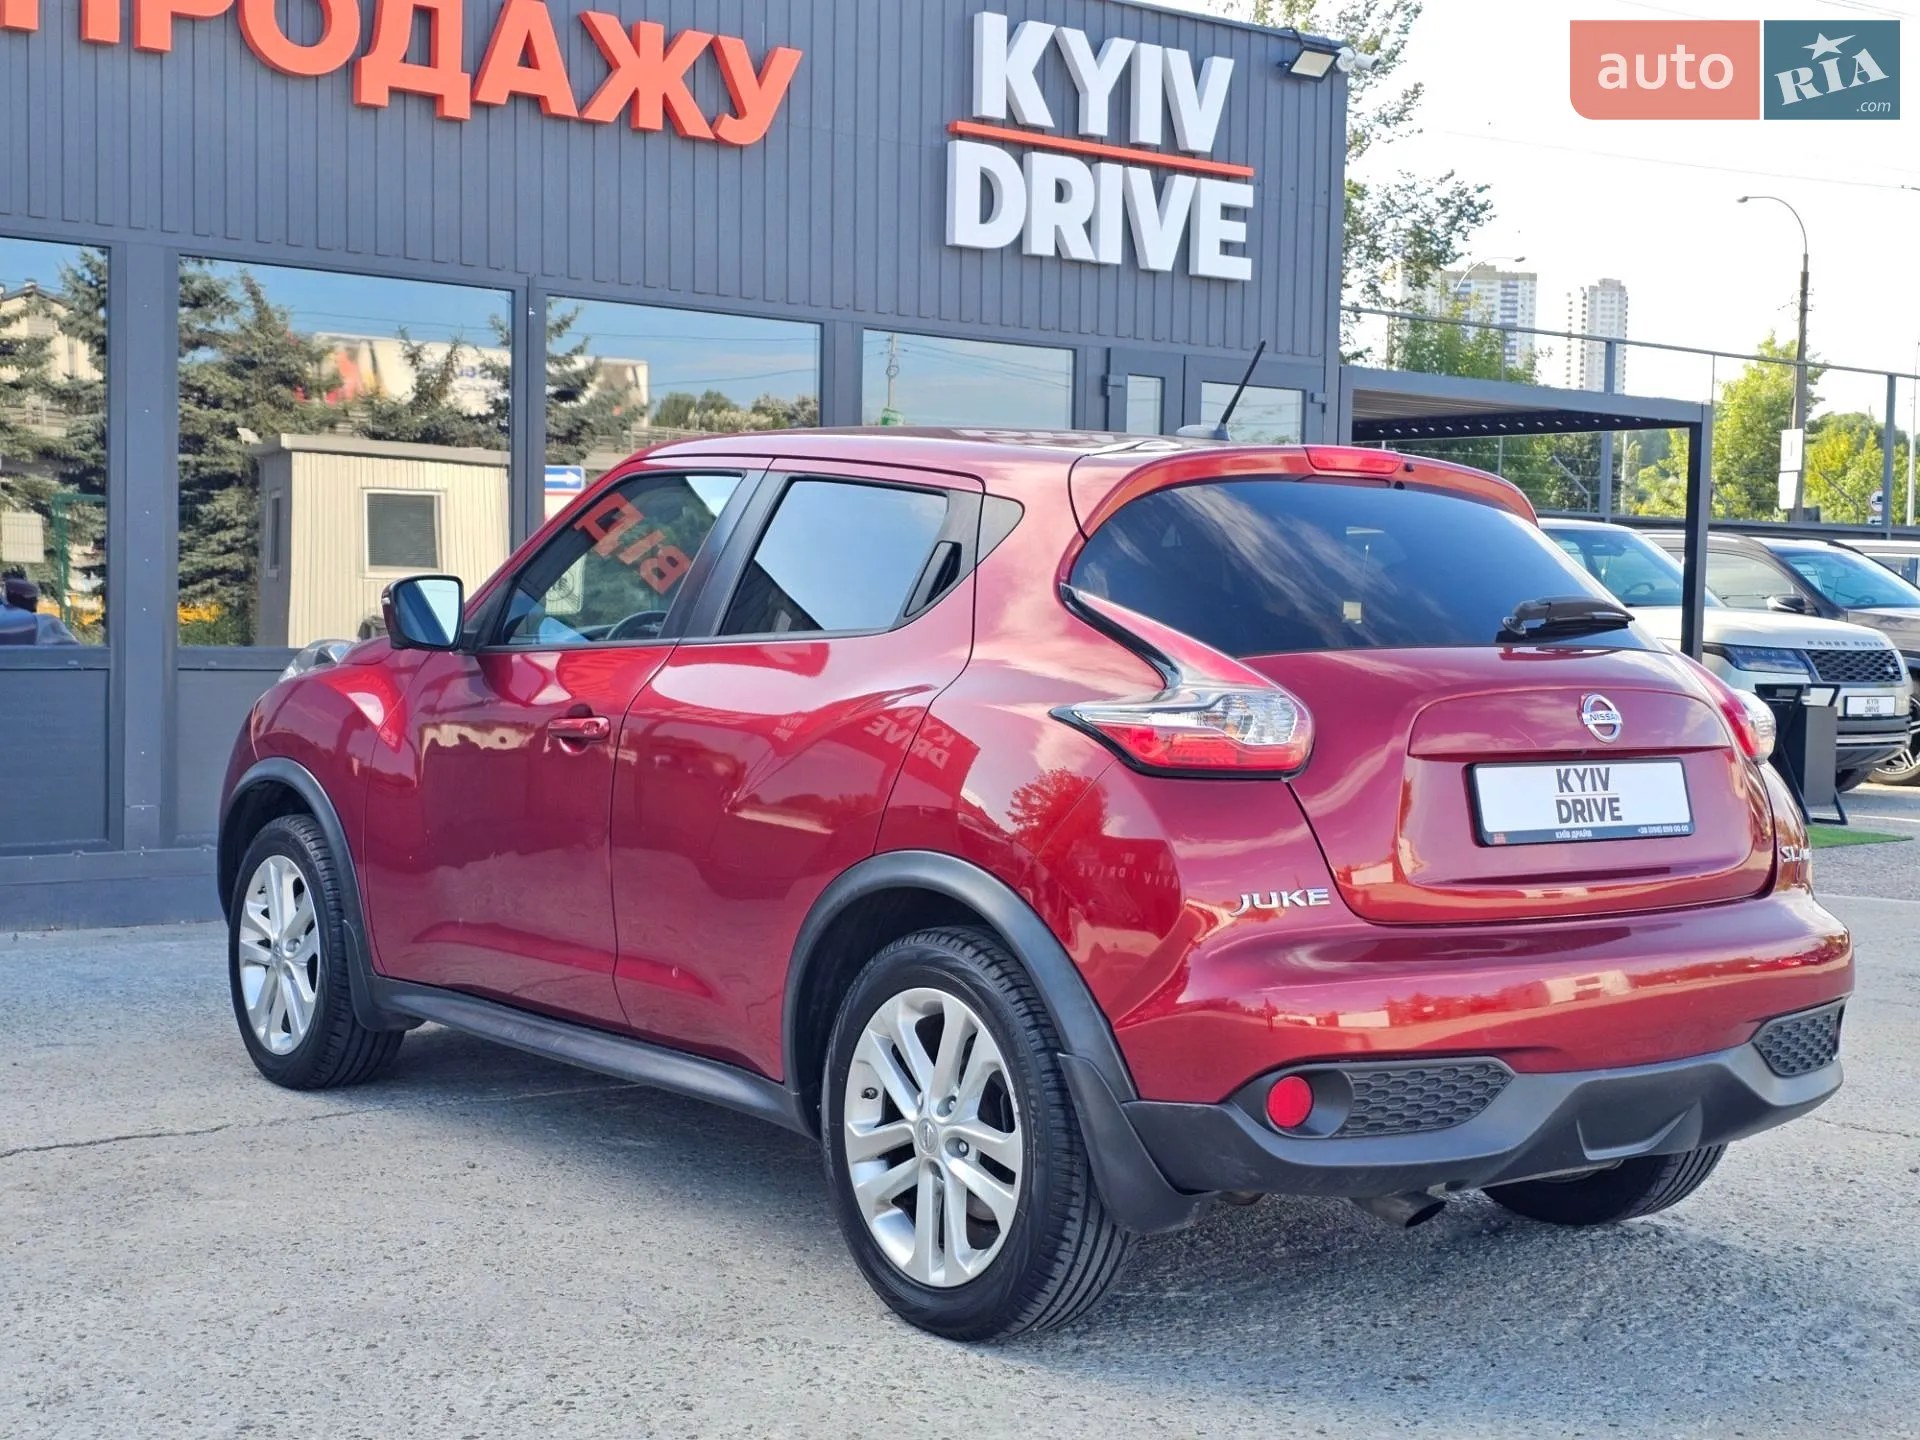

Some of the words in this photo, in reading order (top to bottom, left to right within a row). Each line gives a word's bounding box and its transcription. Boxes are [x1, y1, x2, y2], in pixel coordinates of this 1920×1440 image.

[972, 11, 1235, 153] KYIV
[946, 139, 1254, 281] DRIVE
[1588, 712, 1620, 722] NISSAN
[1556, 767, 1610, 793] KYIV
[1556, 797, 1623, 824] DRIVE
[1229, 888, 1331, 917] JUKE
